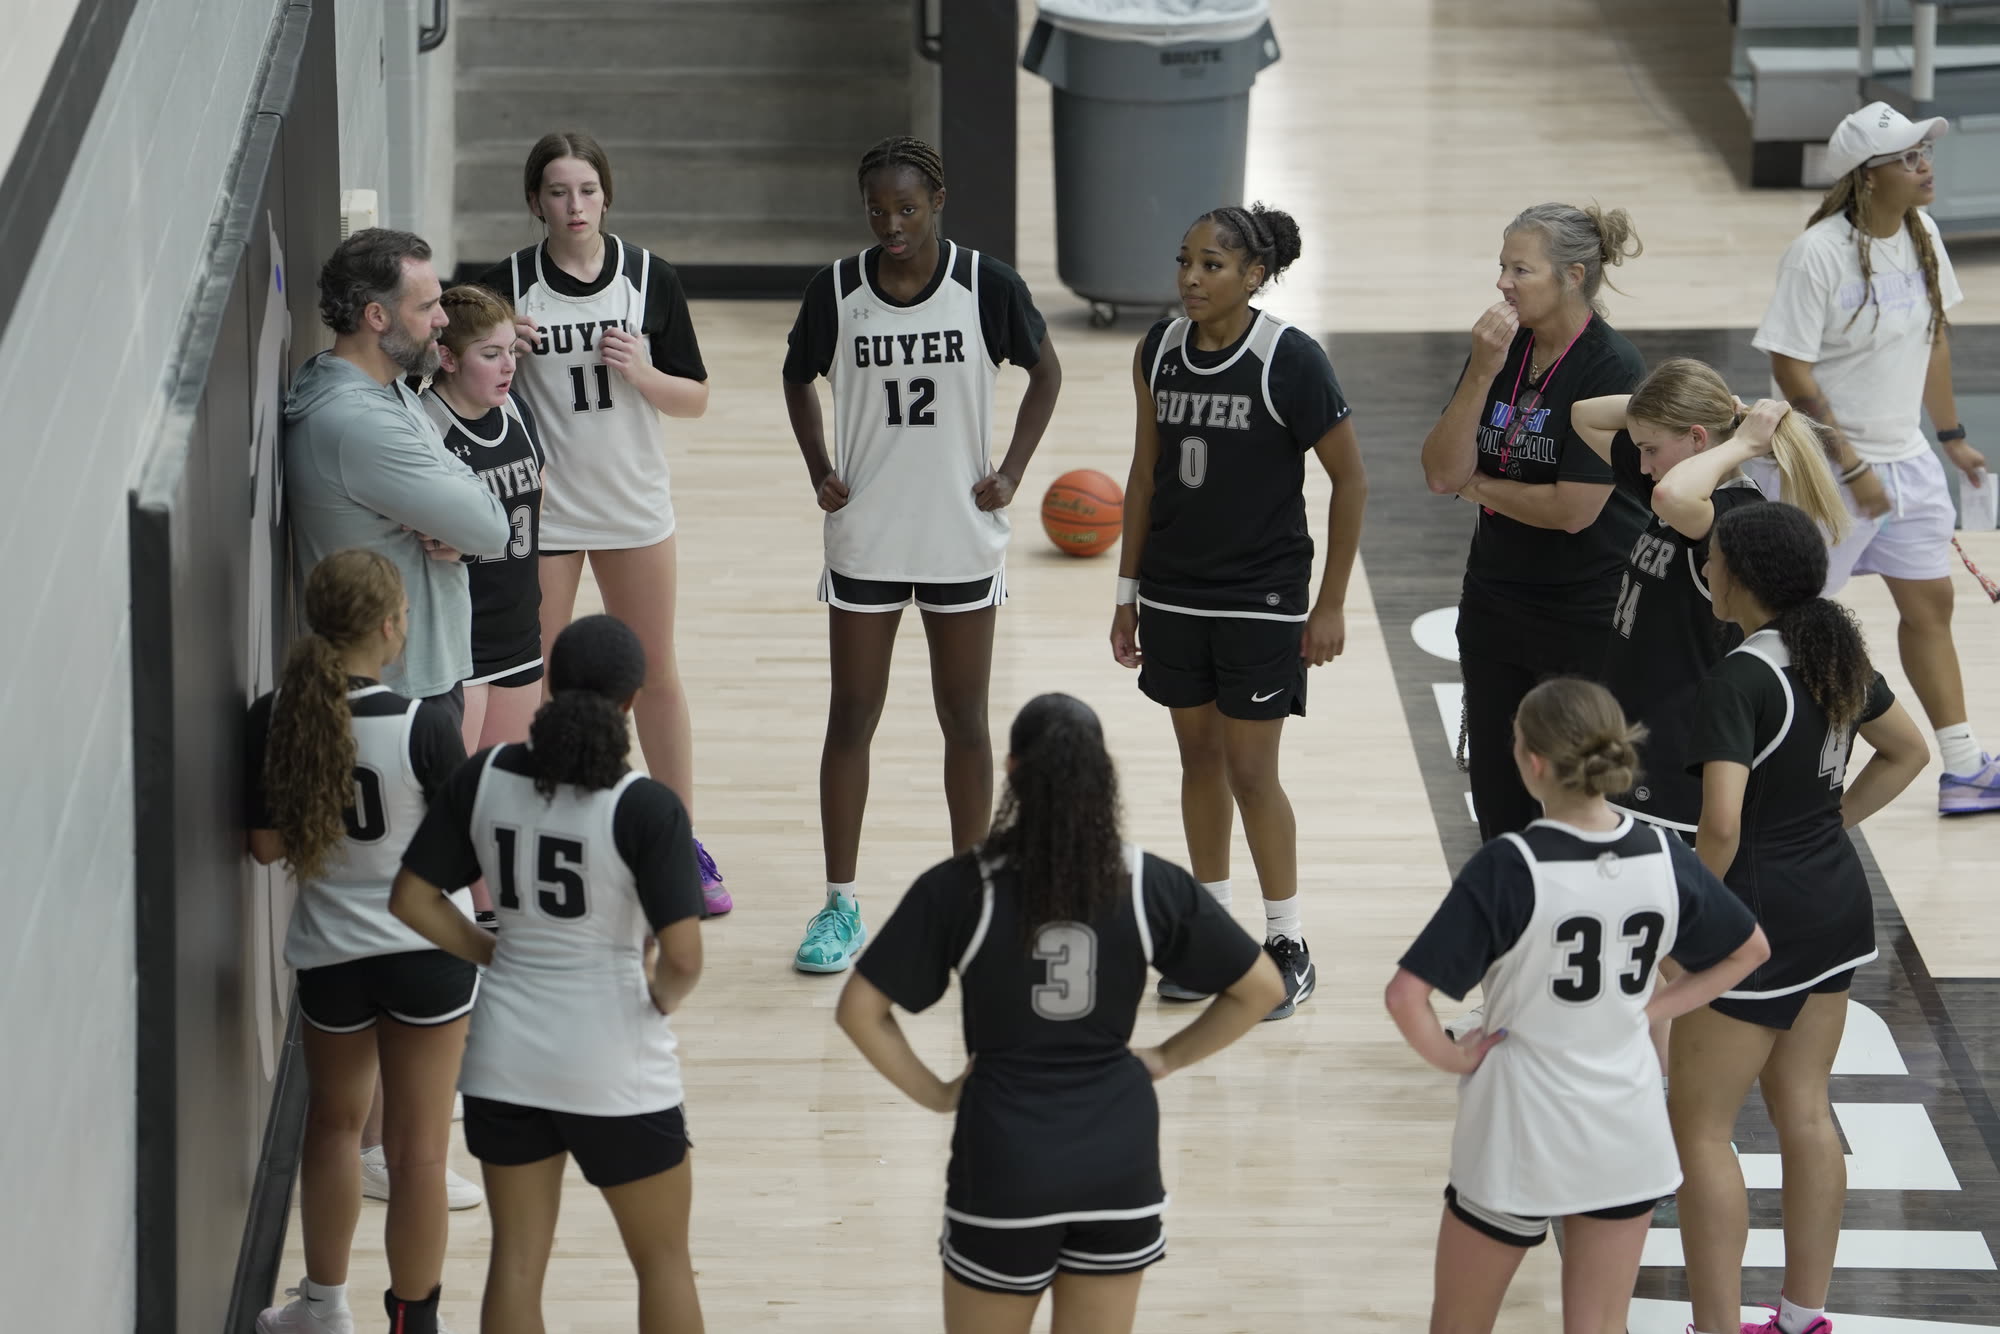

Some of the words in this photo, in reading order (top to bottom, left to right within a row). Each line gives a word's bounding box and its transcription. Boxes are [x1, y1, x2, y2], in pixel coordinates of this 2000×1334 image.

[531, 319, 627, 356] GUY
[854, 329, 966, 369] GUYER
[567, 362, 616, 414] 11
[882, 375, 938, 428] 12
[1156, 389, 1252, 431] GUYER
[477, 456, 543, 499] UYER
[1179, 436, 1208, 489] 0
[1818, 713, 1851, 791] 4
[491, 819, 593, 926] 15
[1031, 921, 1098, 1021] 3
[1548, 905, 1666, 1008] 33
